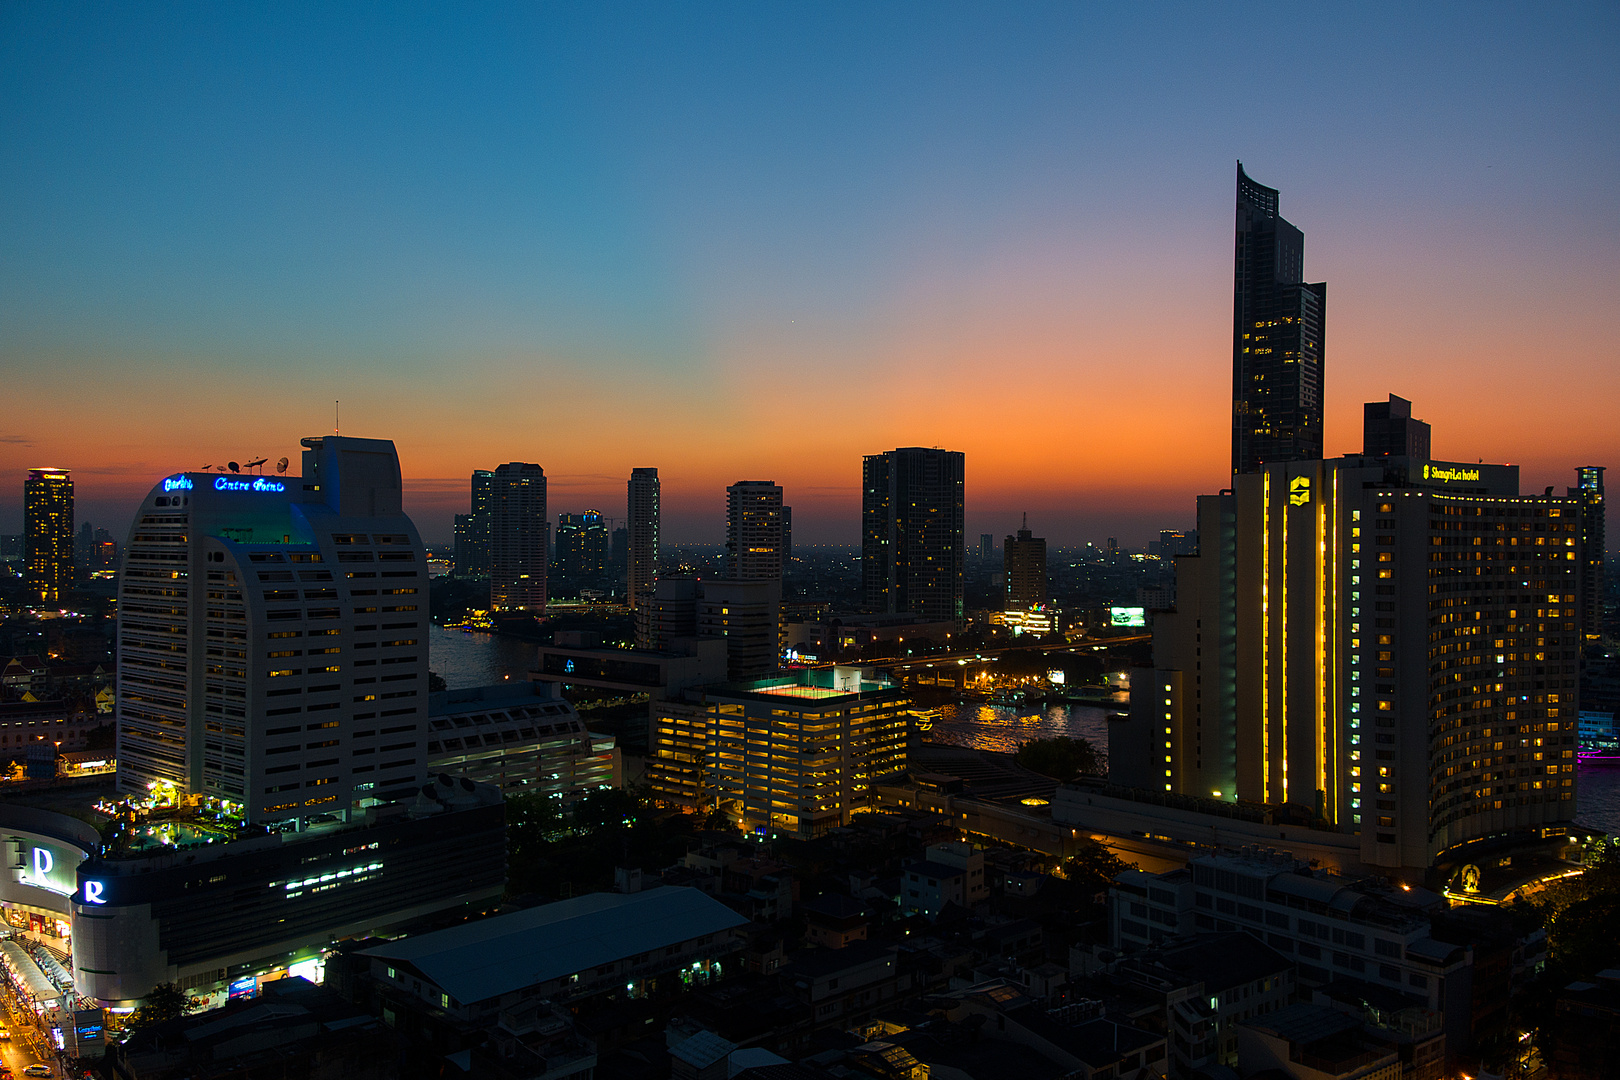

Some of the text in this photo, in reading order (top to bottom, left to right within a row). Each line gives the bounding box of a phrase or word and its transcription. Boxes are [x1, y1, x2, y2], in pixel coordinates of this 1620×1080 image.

[1462, 468, 1480, 481] hotel
[215, 477, 285, 492] Centre Point
[84, 881, 107, 904] R
